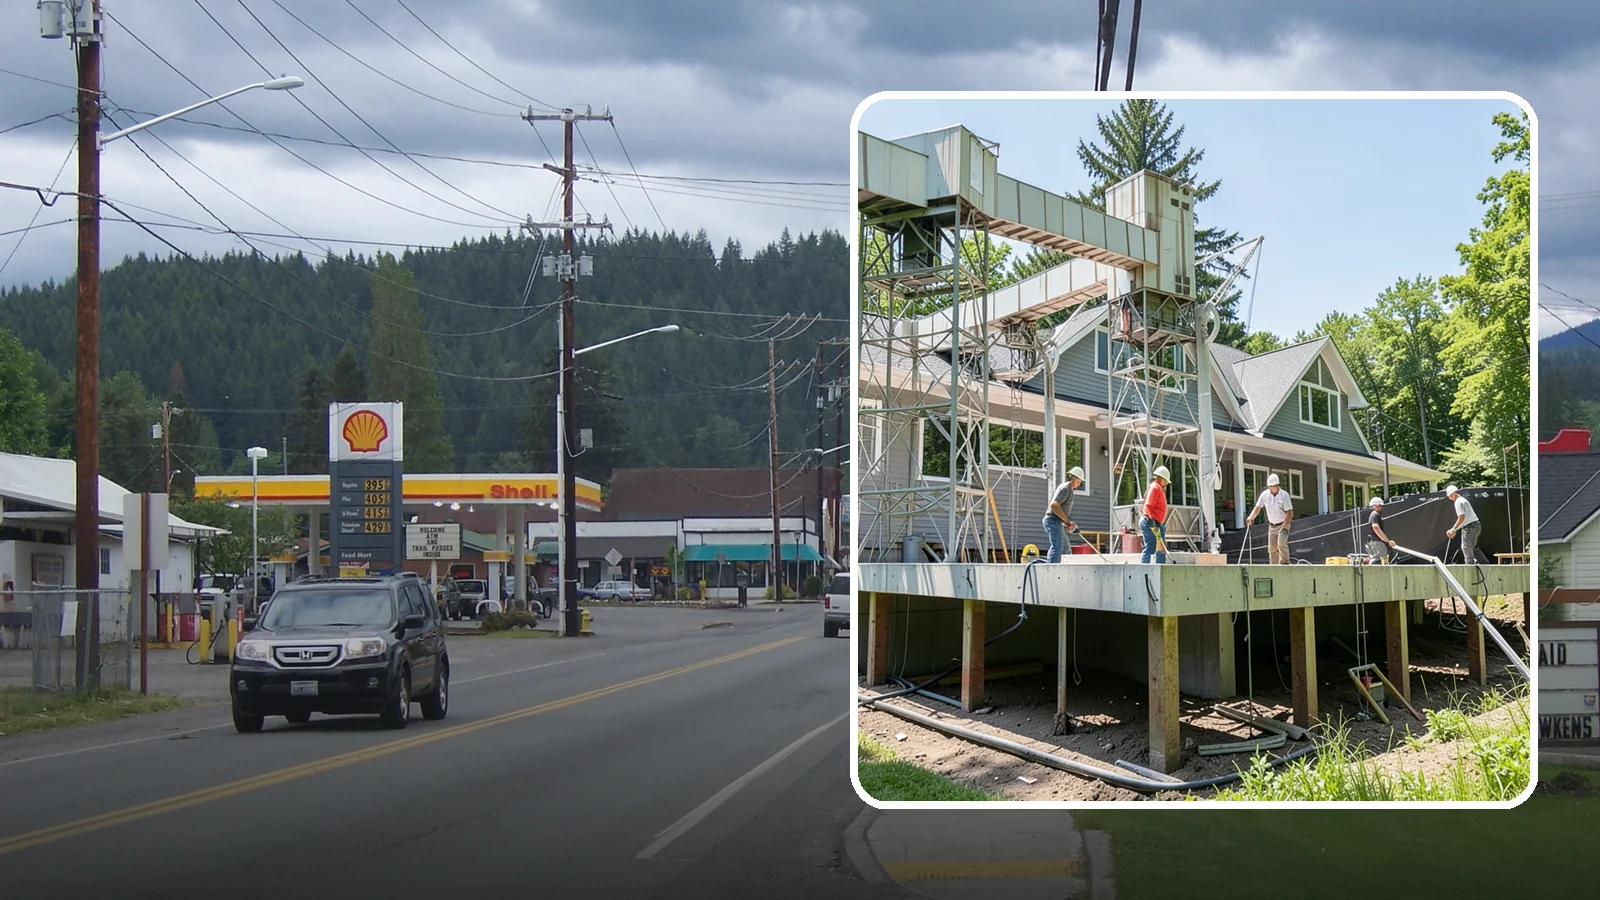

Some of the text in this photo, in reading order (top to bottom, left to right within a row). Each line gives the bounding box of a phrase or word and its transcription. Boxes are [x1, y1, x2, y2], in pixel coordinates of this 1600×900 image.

[366, 480, 384, 490] 395
[490, 484, 547, 499] Shell
[366, 494, 384, 504] 405
[366, 508, 383, 518] 415
[366, 522, 384, 532] 429
